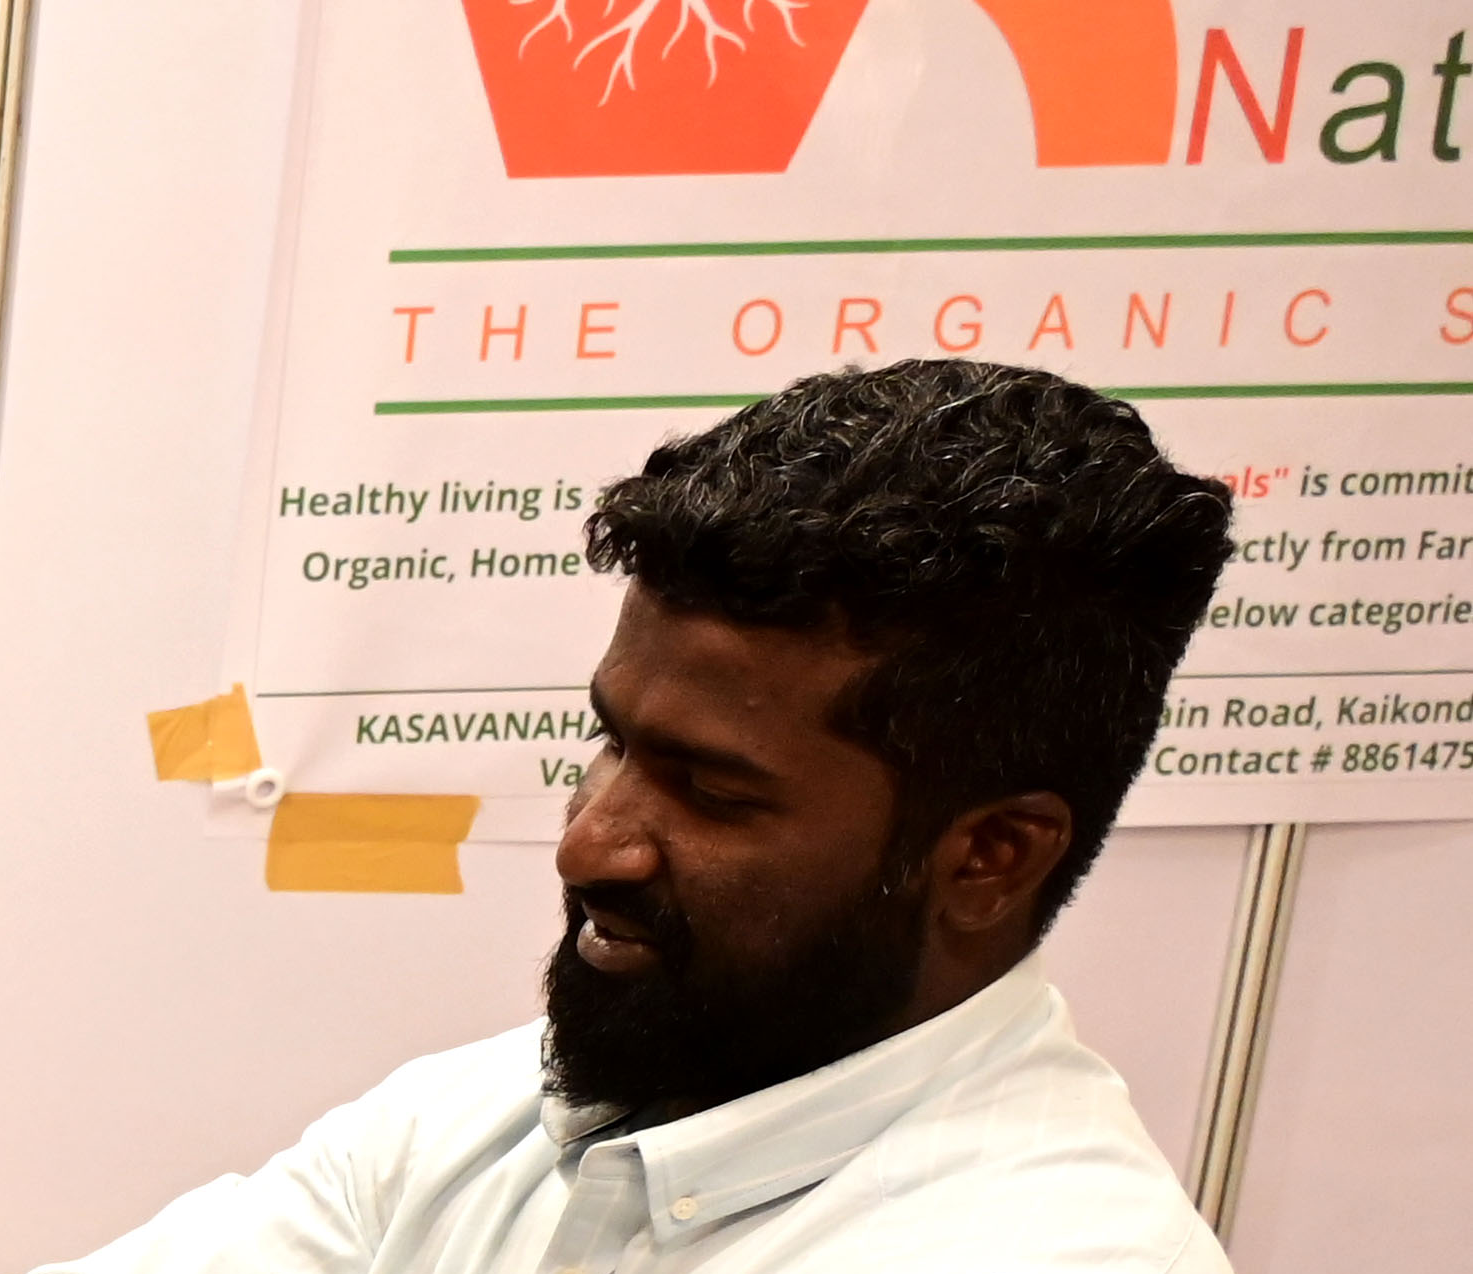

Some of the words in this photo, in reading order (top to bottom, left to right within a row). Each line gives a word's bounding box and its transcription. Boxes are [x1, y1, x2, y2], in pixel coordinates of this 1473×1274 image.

[1186, 25, 1473, 165] Nat
[392, 302, 622, 364] THE
[731, 286, 1333, 358] ORGANIC
[1300, 465, 1329, 497] is
[278, 481, 429, 524] Healthy
[439, 480, 543, 521] living
[553, 479, 582, 511] is
[1320, 531, 1406, 562] from
[302, 547, 457, 590] Organic,
[470, 547, 581, 578] Home
[1222, 696, 1322, 730] Road,
[1154, 746, 1300, 776] Contact
[1310, 745, 1333, 771] #
